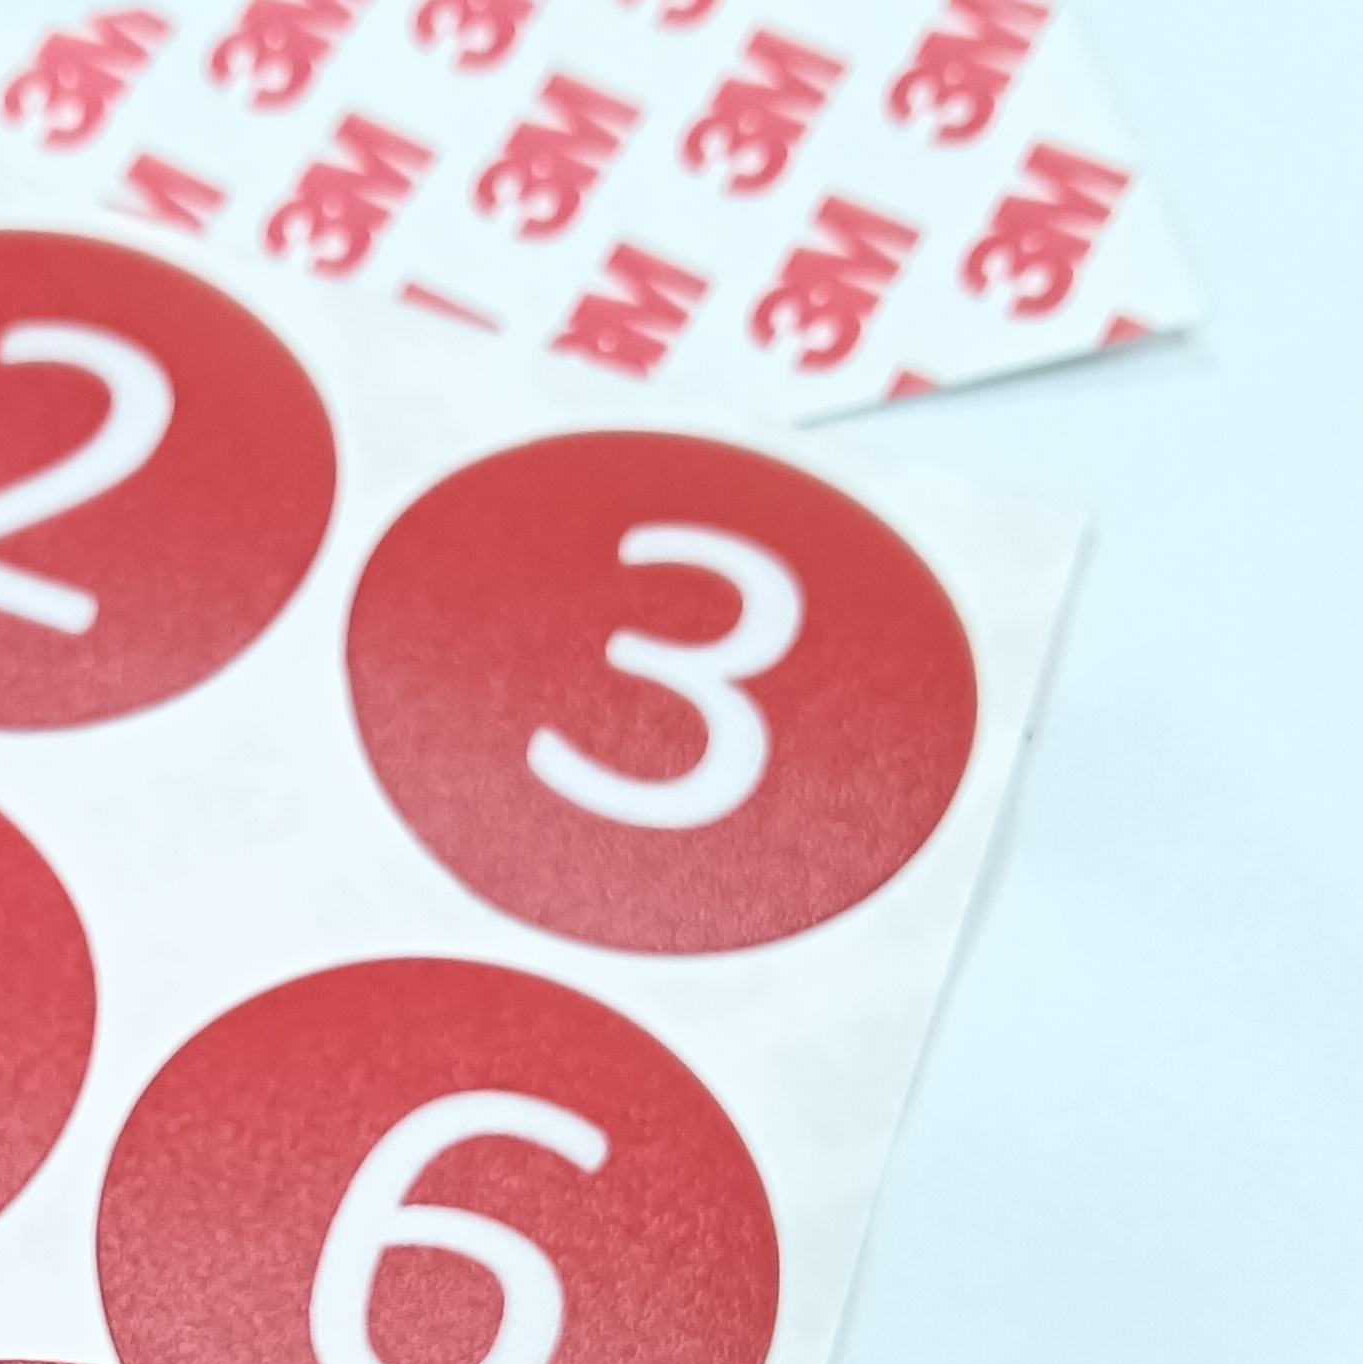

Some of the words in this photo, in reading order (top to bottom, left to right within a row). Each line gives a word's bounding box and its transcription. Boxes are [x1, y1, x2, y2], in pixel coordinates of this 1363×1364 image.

[0, 8, 169, 149] 3M
[412, 0, 536, 71] 3
[680, 29, 844, 196] 3M
[887, 0, 1050, 145] 3M
[262, 113, 433, 279] 3M
[472, 72, 639, 240] 3M
[960, 143, 1130, 319] 3M
[749, 195, 920, 372] 3M
[526, 526, 803, 830] 3
